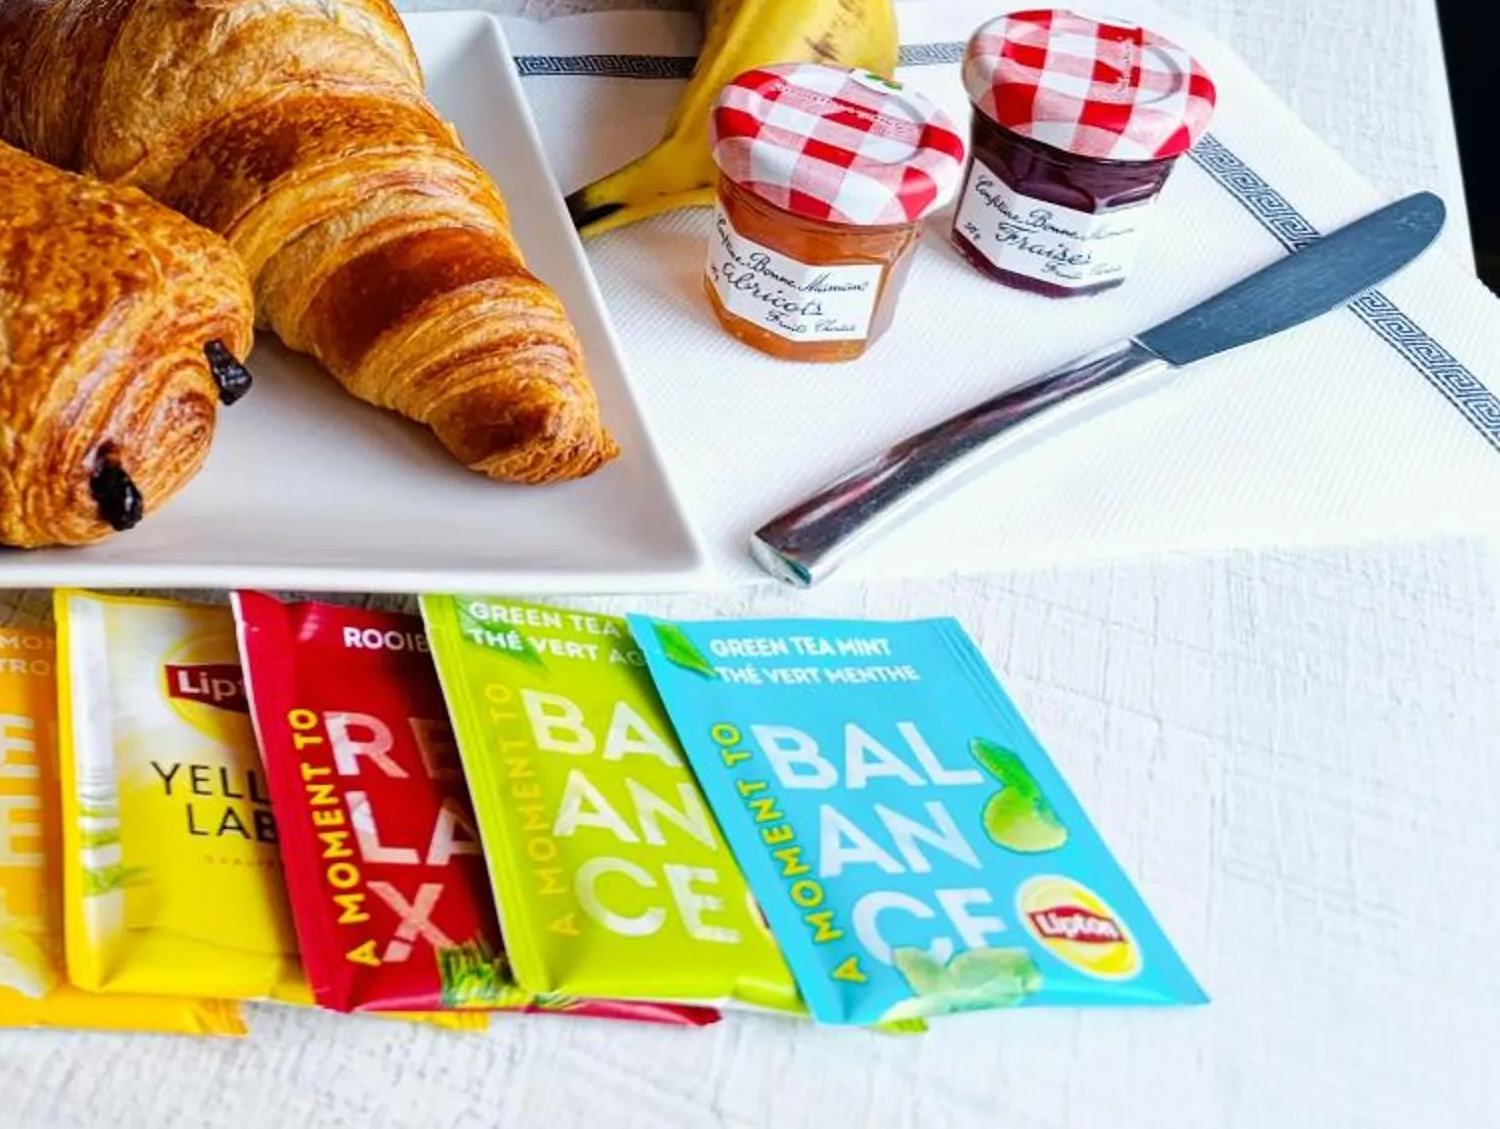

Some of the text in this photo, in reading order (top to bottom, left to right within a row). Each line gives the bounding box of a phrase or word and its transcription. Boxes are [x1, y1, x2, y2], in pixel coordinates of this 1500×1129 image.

[468, 602, 622, 639] GREEN TEA
[468, 628, 524, 652] THÉ
[530, 637, 601, 662] VERT
[709, 635, 892, 658] GREEN TEA MINT
[177, 669, 247, 702] Lip
[714, 662, 922, 685] THÉ VERT MENTHE
[519, 688, 685, 769] BA
[750, 721, 985, 789] BAL
[288, 708, 384, 966] A MOMENT TO
[343, 791, 482, 866] LA
[484, 683, 579, 938] A MOMENT TO
[553, 768, 719, 852] AN
[818, 800, 983, 878] AN
[710, 722, 868, 984] A MOMENT TO
[365, 881, 462, 963] X
[574, 856, 742, 945] CE
[1034, 909, 1121, 942] Lipton
